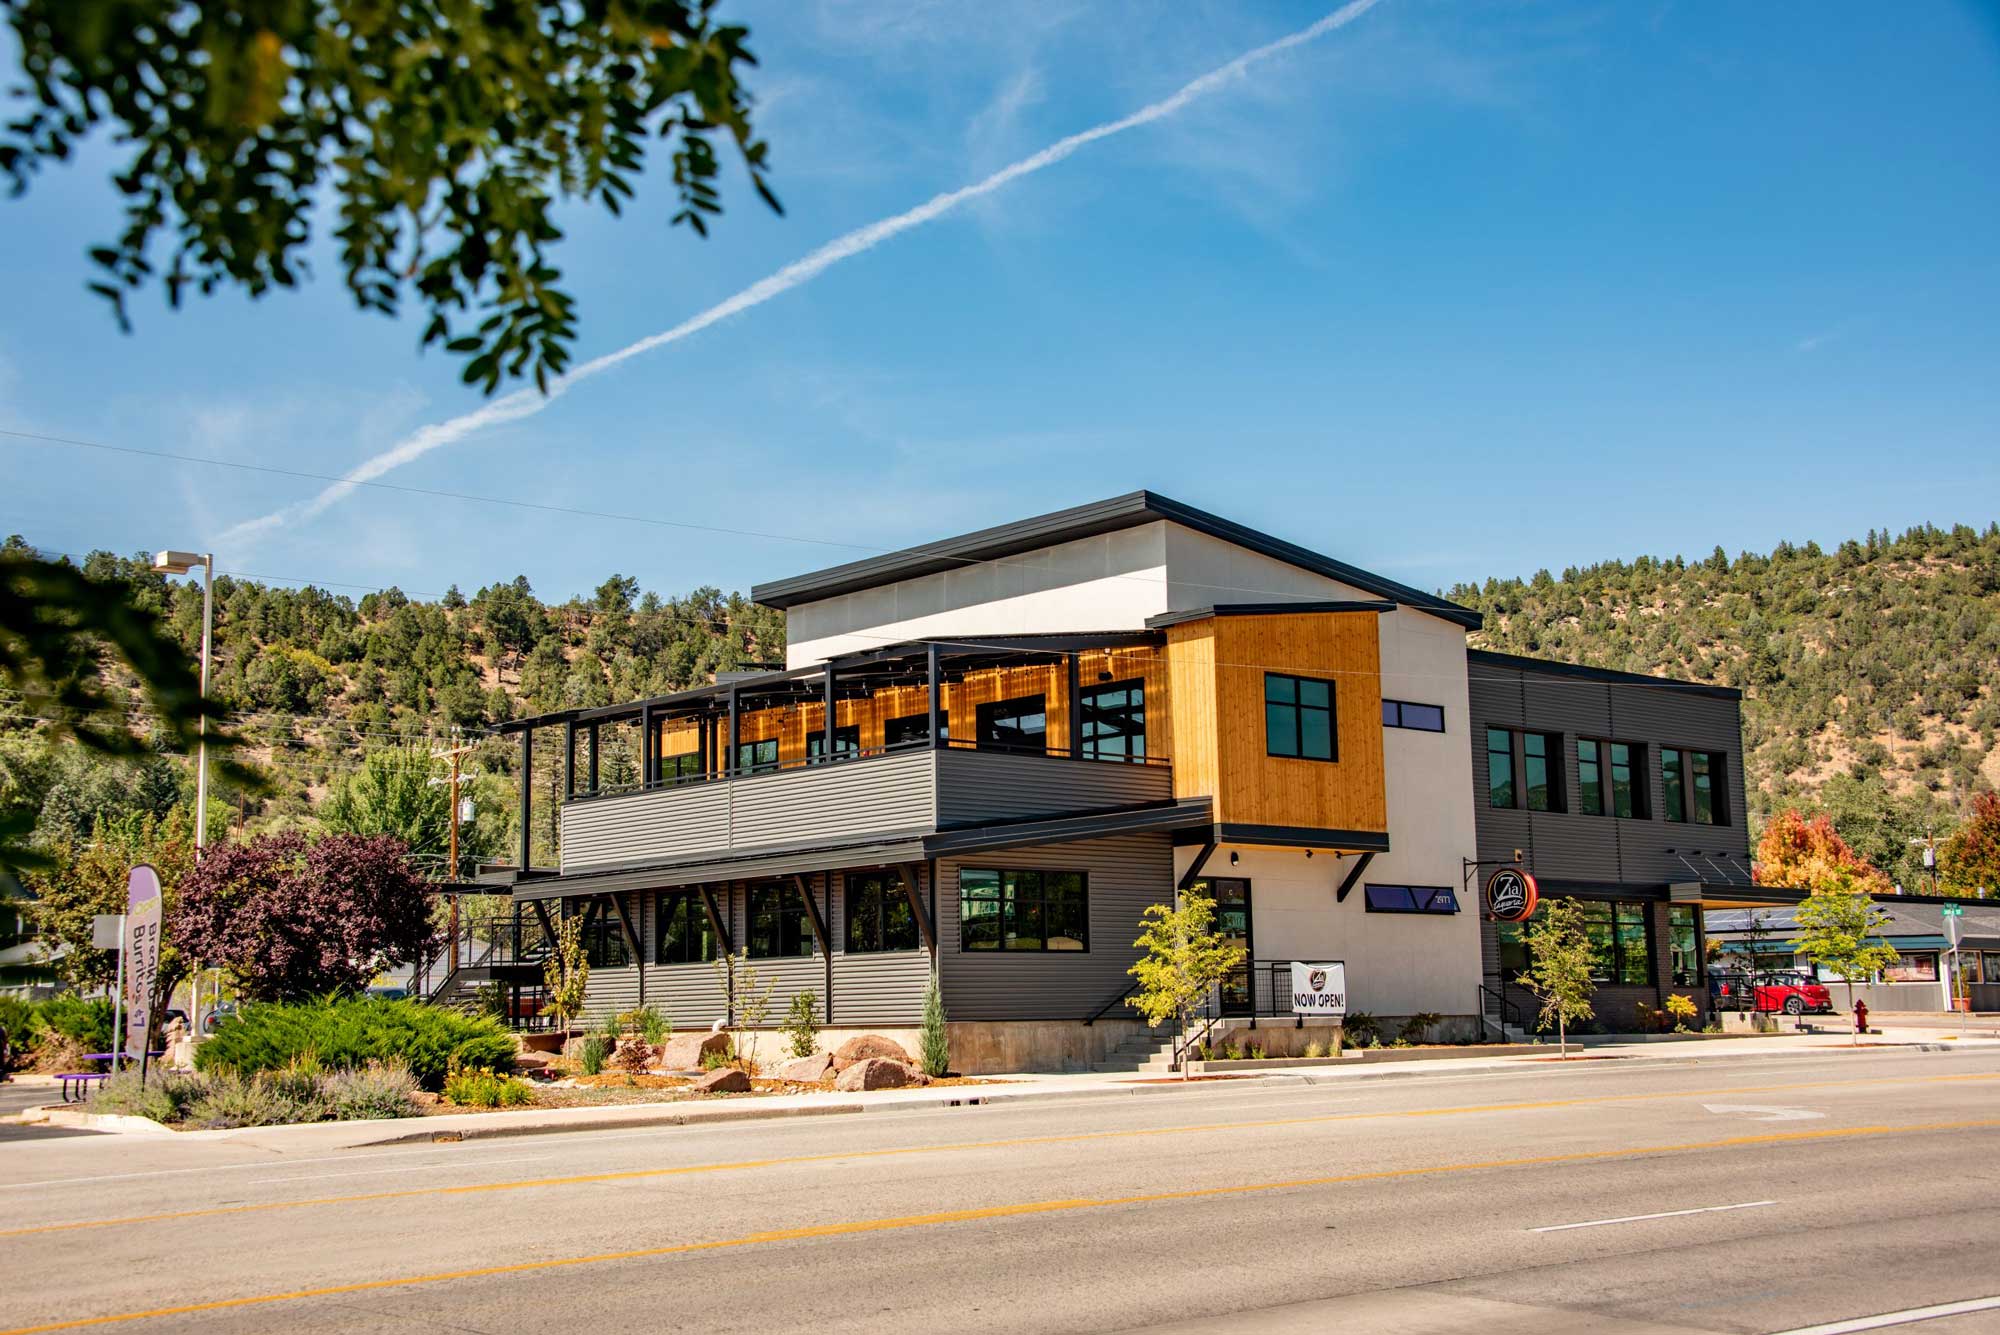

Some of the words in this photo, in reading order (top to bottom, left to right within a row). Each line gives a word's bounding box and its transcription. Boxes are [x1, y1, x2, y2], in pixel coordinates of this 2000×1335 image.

[1497, 876, 1519, 899] Zia
[134, 924, 146, 1005] Burritos
[1294, 993, 1316, 1007] NOW
[1318, 993, 1344, 1007] OPEN!
[132, 1009, 145, 1027] $7
